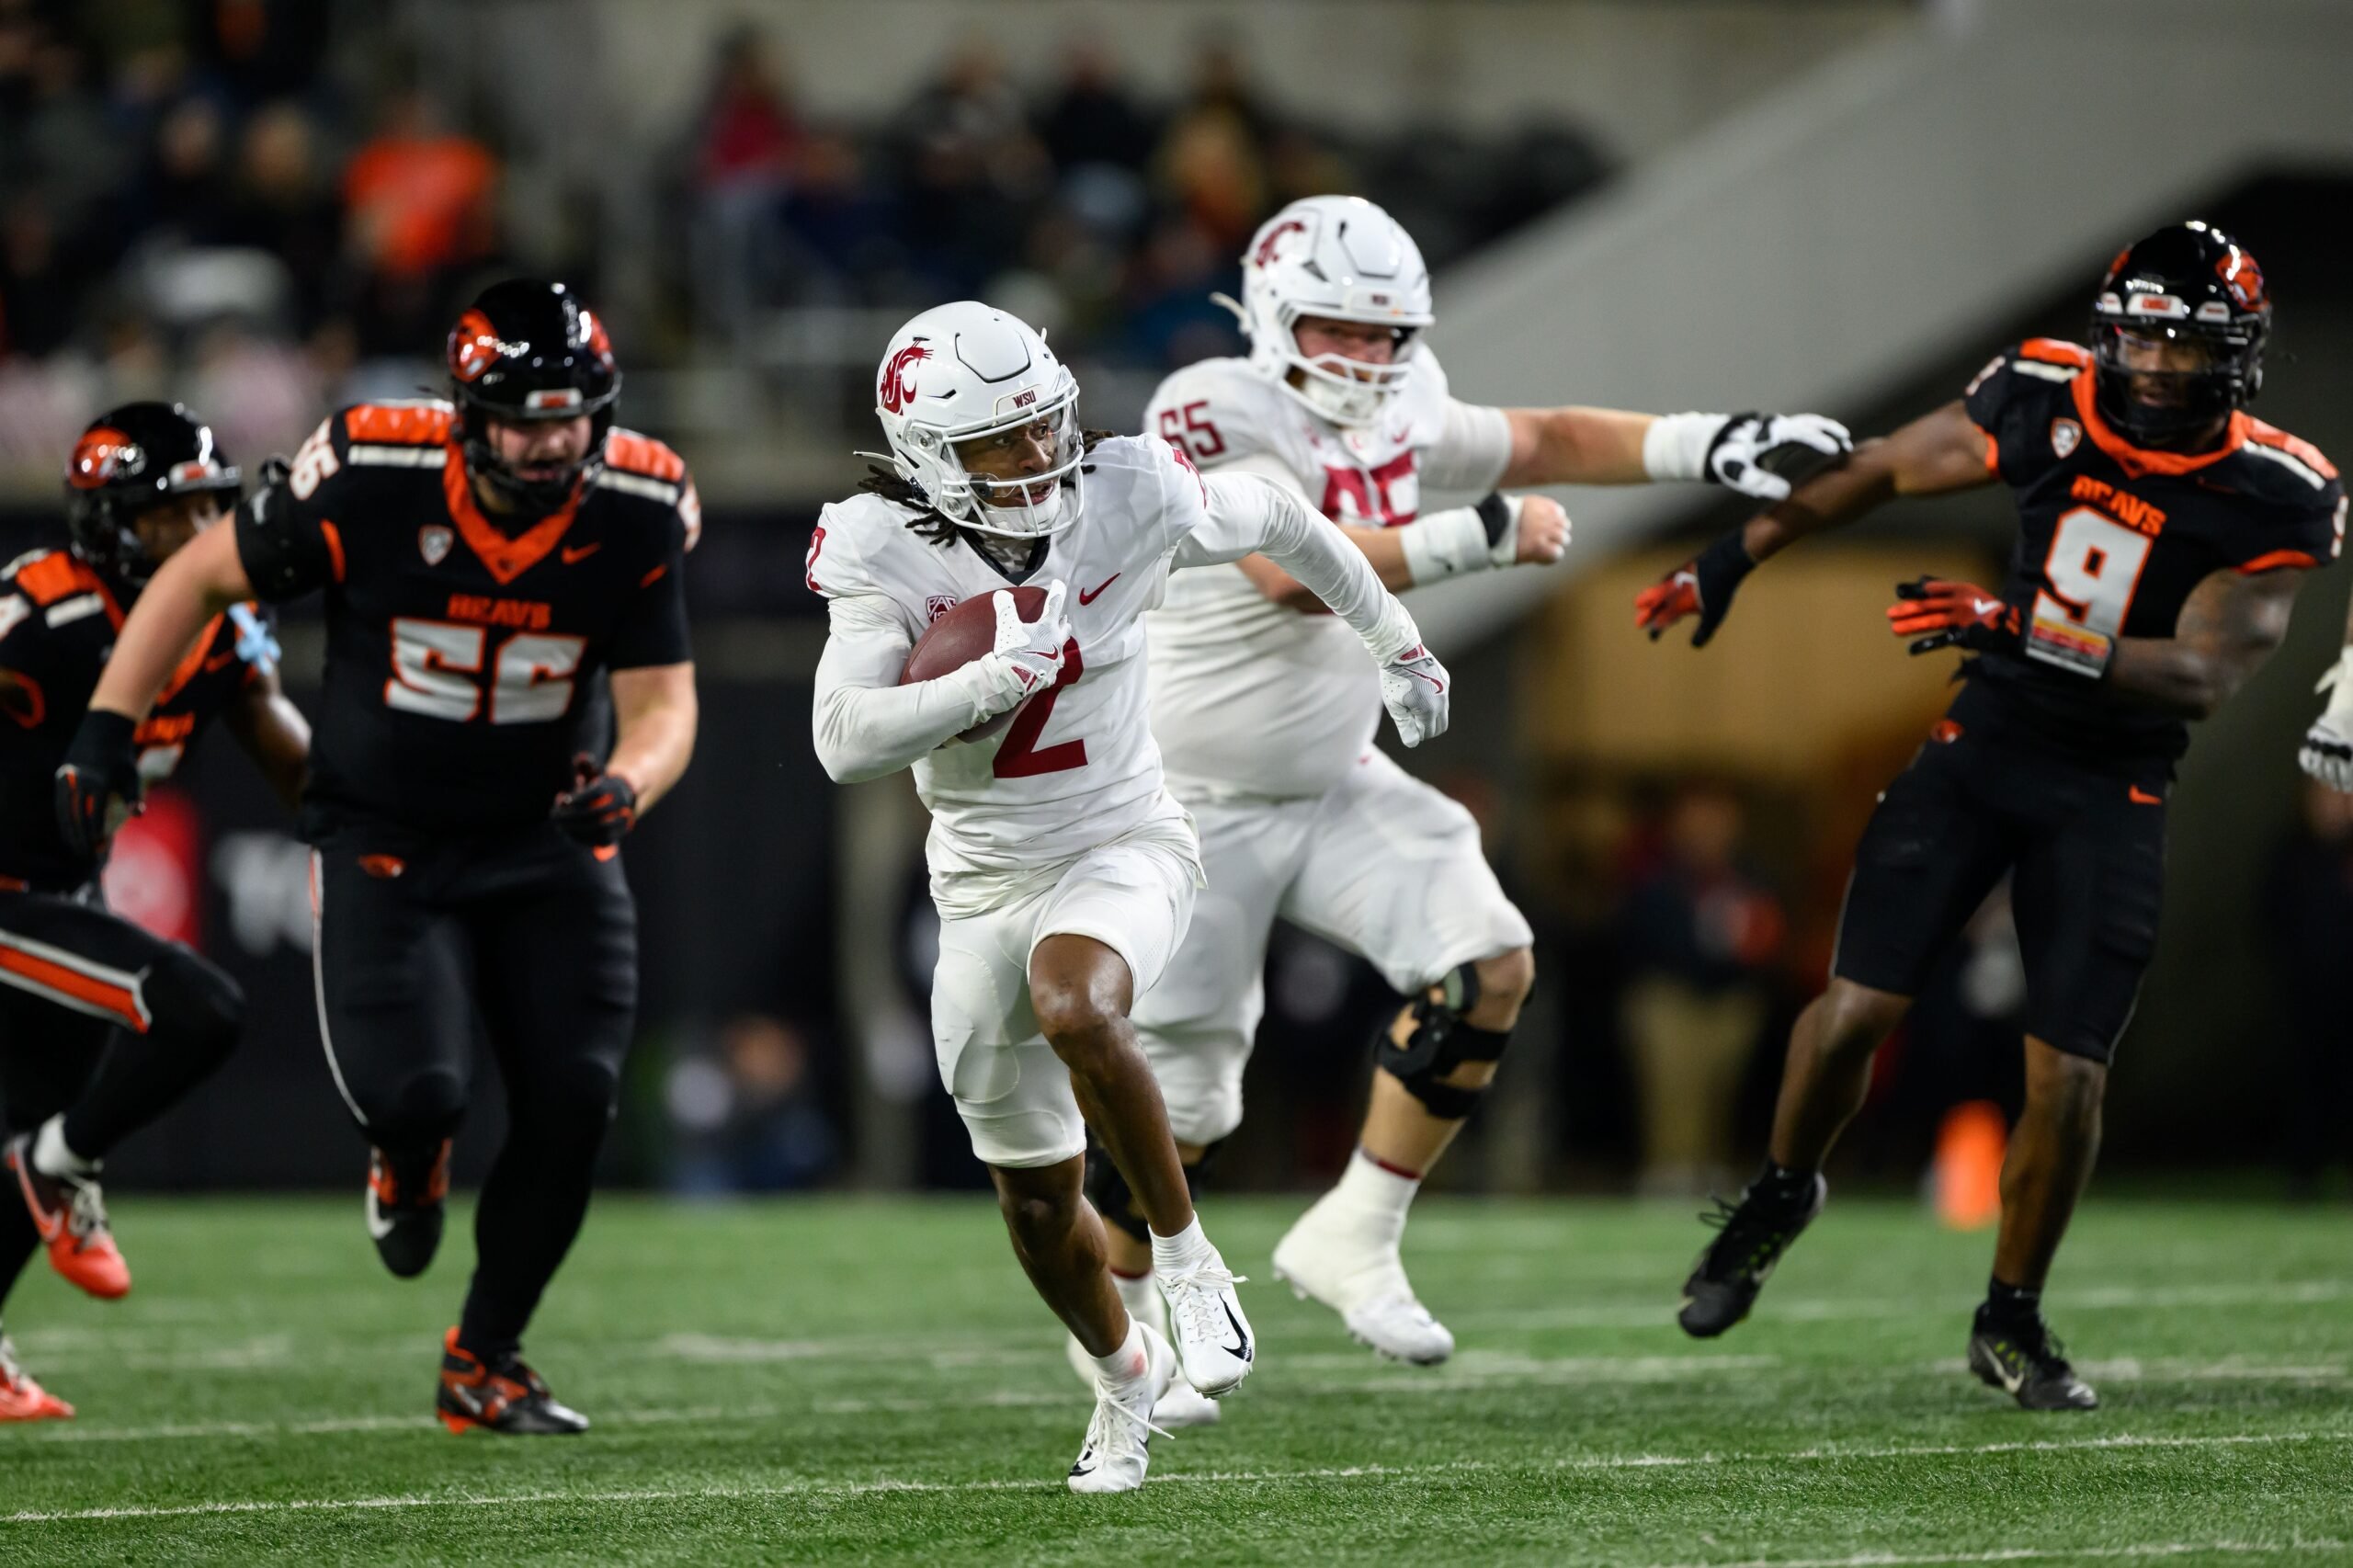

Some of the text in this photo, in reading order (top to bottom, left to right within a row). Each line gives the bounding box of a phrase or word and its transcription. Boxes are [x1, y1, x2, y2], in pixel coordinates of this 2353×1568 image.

[1013, 390, 1036, 408] WSU
[1159, 400, 1226, 462] 65
[2071, 473, 2167, 537] BEAVS
[2032, 506, 2154, 637] 9
[383, 617, 586, 723] 56
[993, 635, 1088, 778] 2
